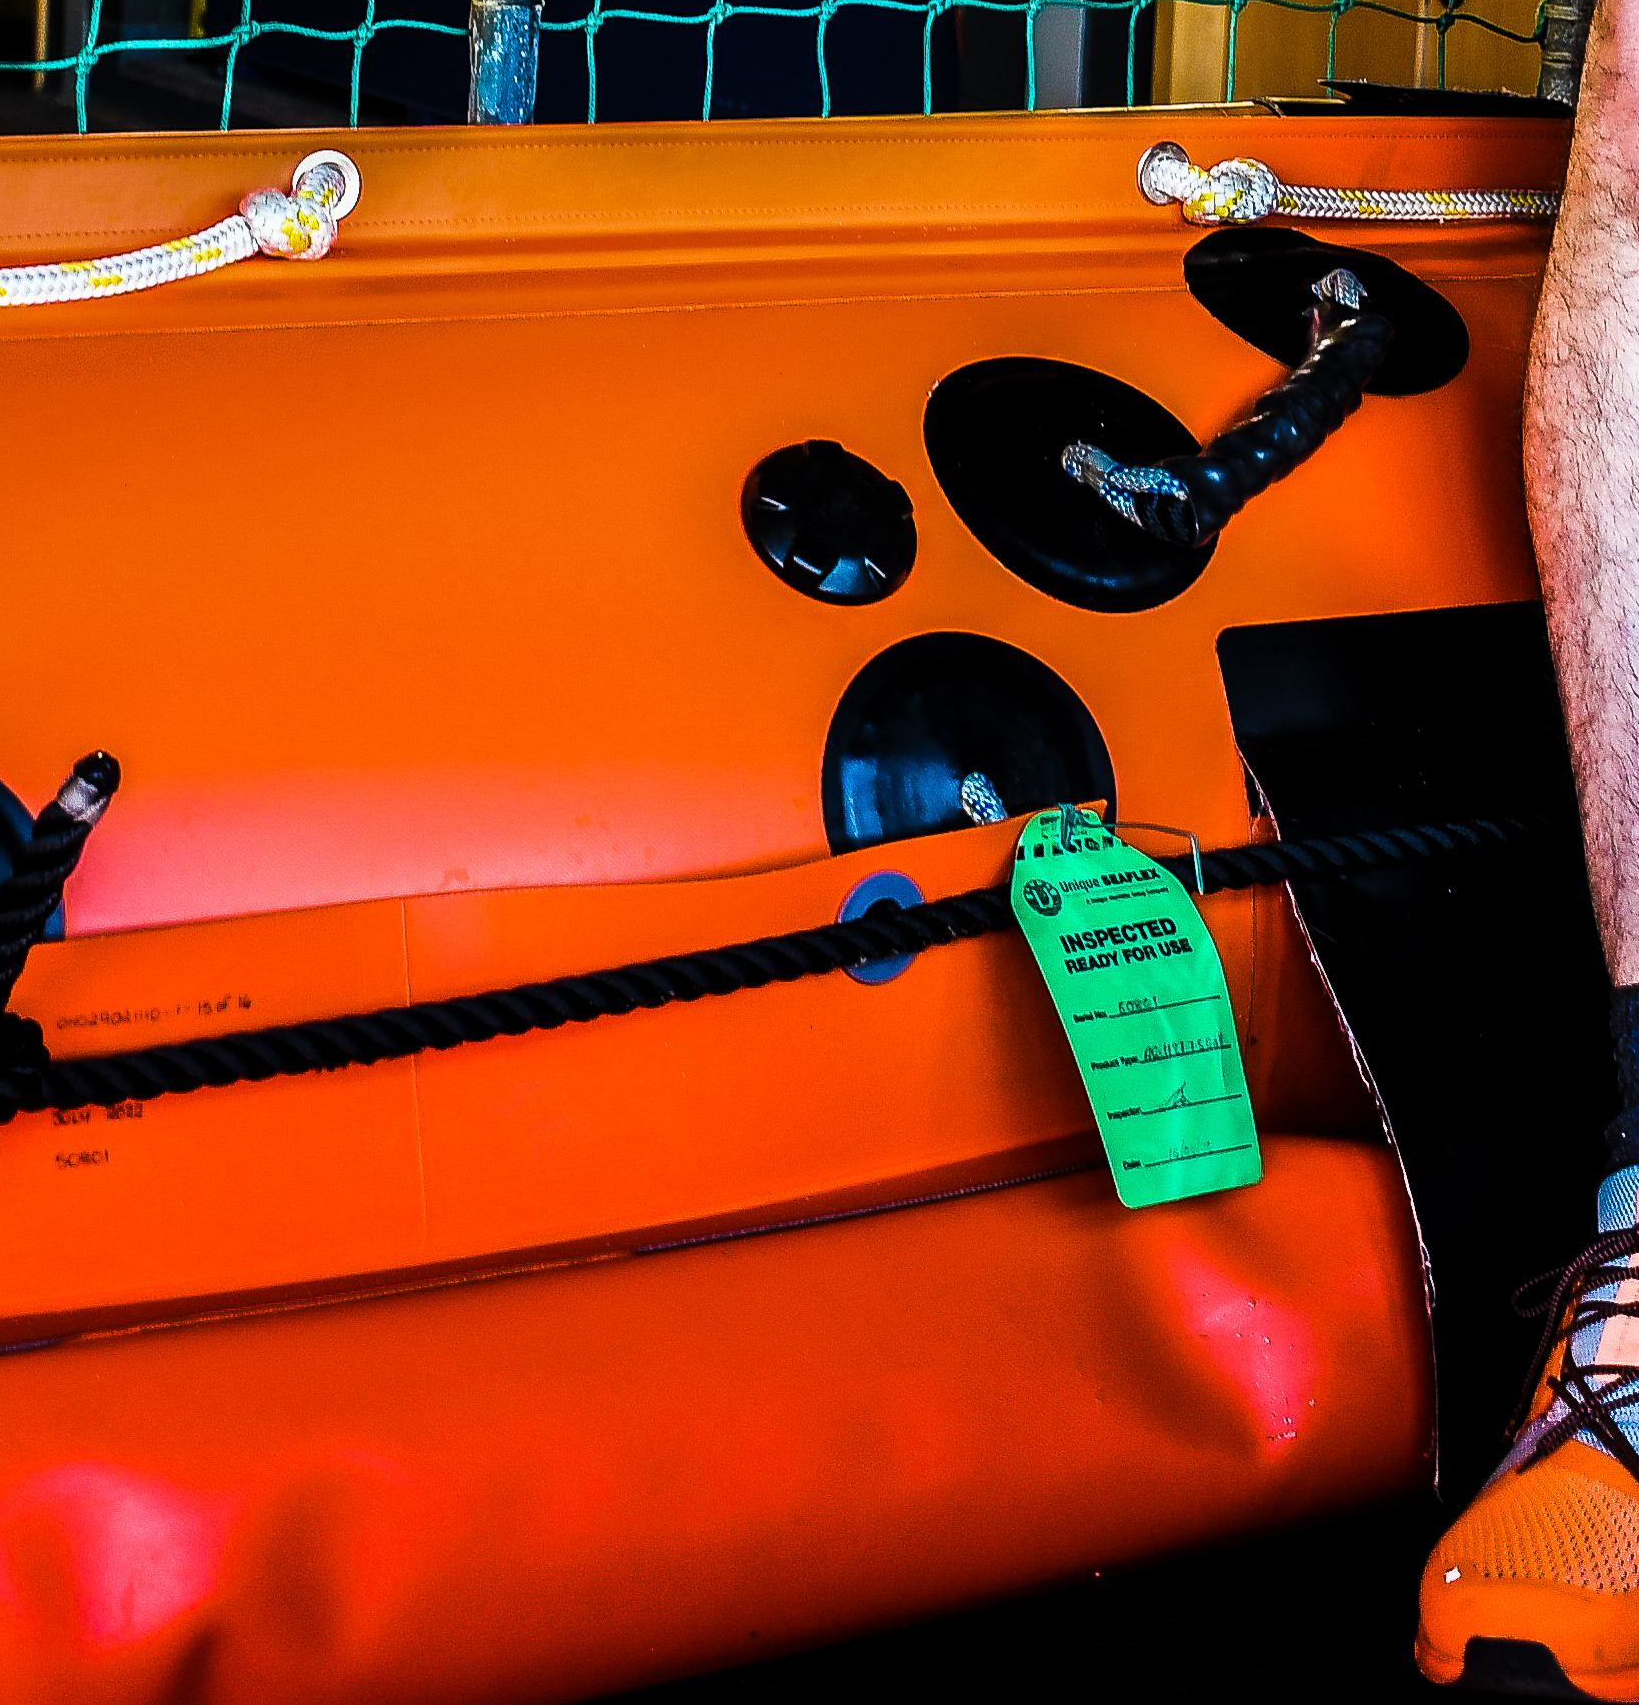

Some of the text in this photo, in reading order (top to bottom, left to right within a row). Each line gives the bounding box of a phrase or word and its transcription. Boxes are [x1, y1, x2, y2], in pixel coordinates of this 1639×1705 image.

[1059, 878, 1101, 893] Unique
[1059, 916, 1177, 954] INSPECTED
[1063, 937, 1192, 975] READY FOR USE
